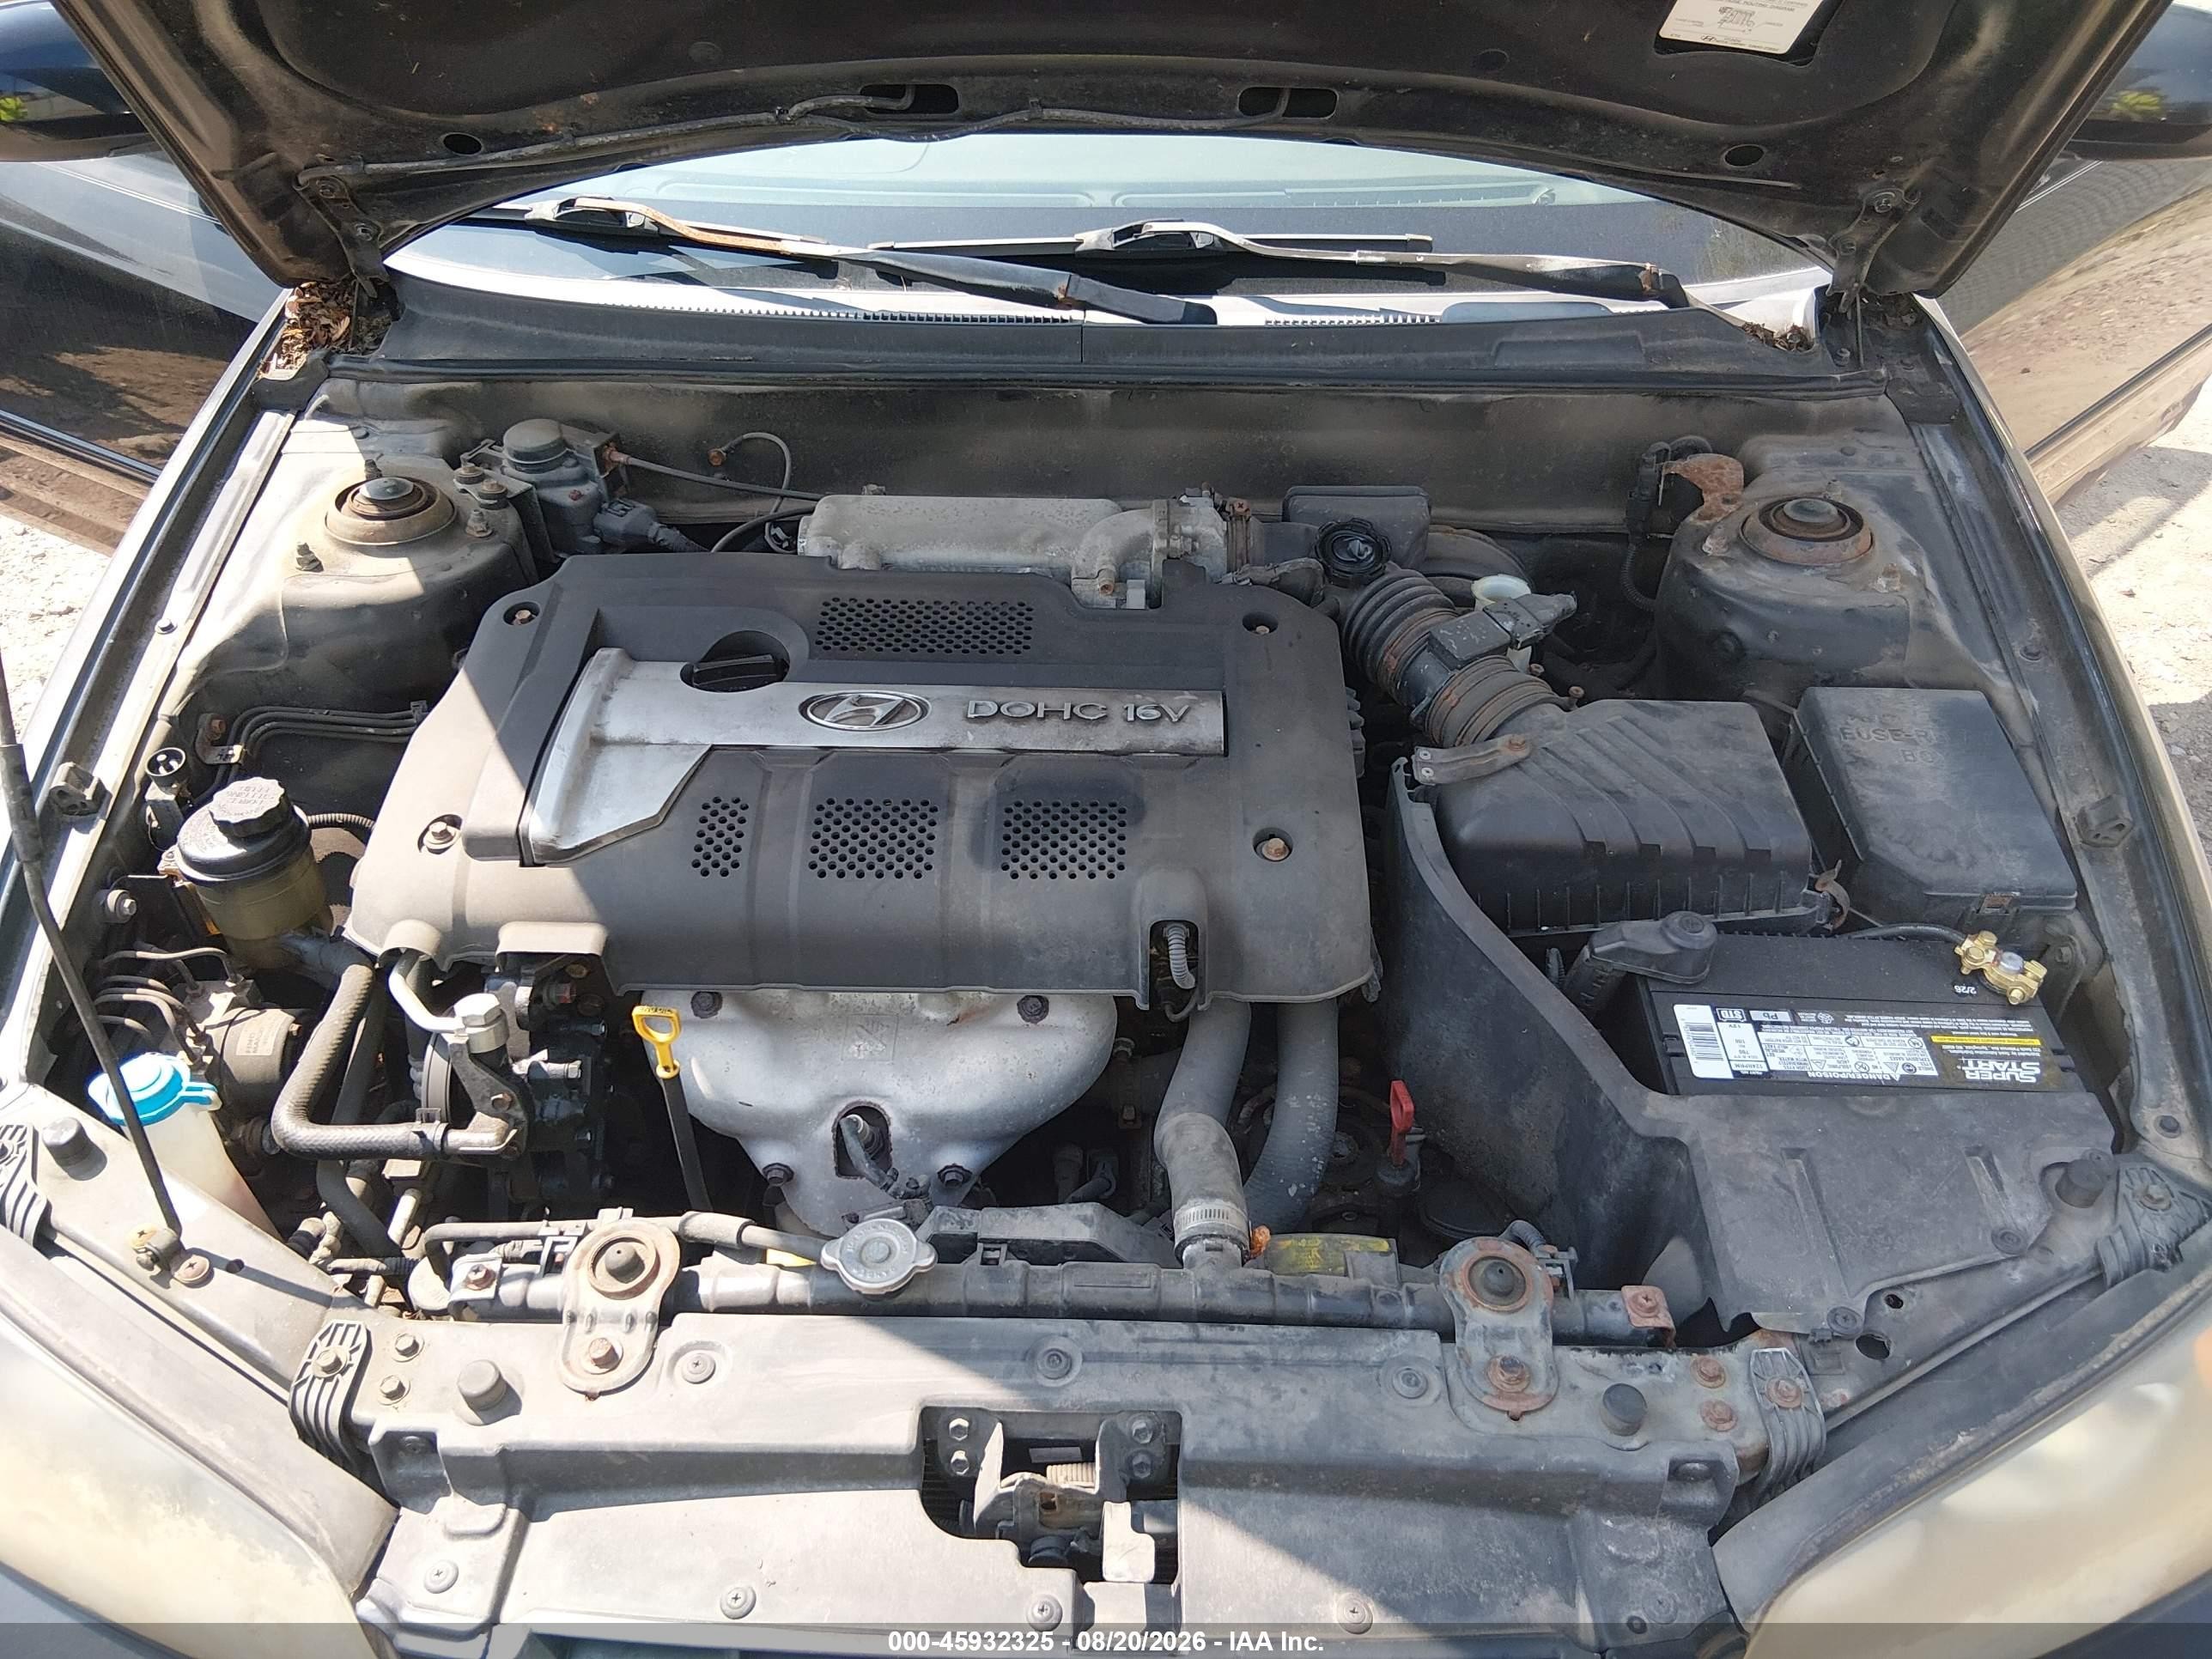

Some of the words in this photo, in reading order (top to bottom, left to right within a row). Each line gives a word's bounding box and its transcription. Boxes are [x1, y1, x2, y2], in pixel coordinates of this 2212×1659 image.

[967, 700, 1108, 720] DOHC
[1122, 702, 1189, 723] 16V
[1962, 1060, 2040, 1073] START
[1808, 1071, 1891, 1080] DANGER/POISON
[1965, 1070, 2036, 1082] SUPER
